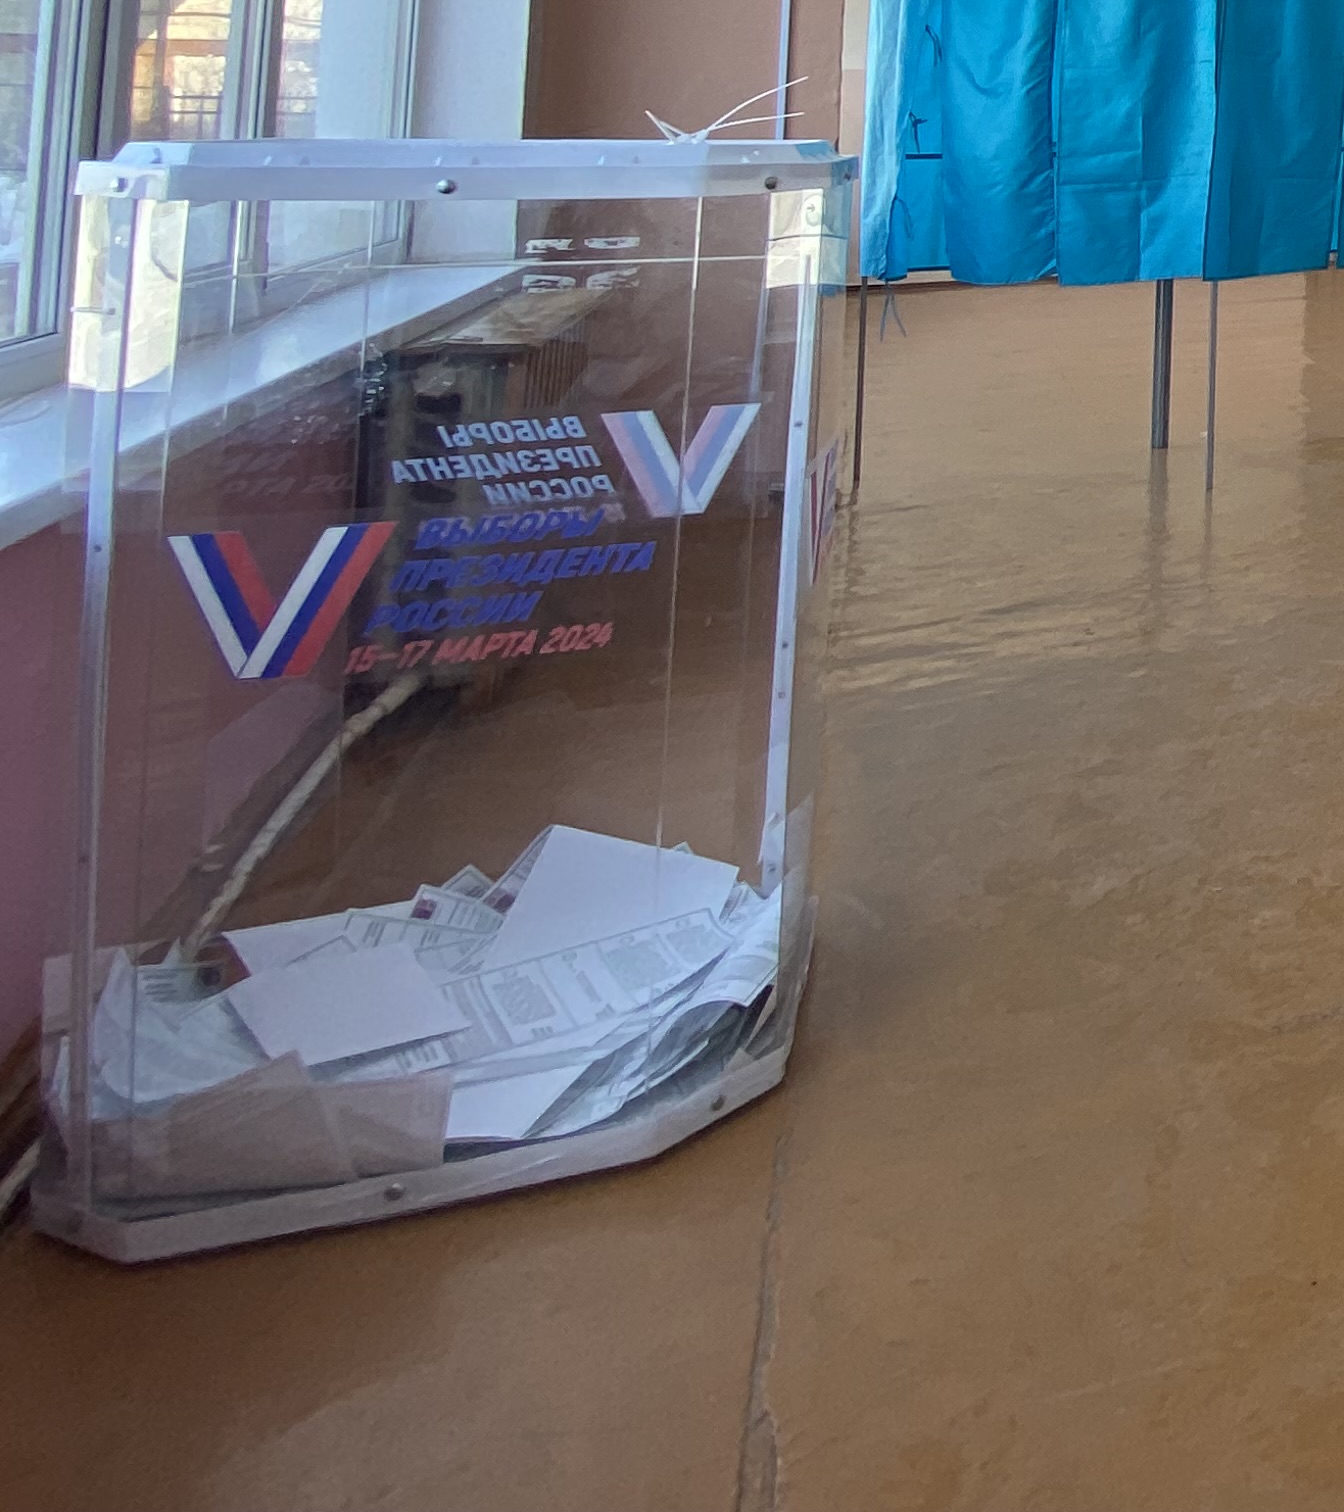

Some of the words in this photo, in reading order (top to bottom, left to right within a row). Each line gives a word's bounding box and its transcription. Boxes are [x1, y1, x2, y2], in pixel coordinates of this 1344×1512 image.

[413, 508, 606, 551] ВЫБОРЫ
[390, 541, 657, 593] ПРЕЗИДЕНТА
[362, 590, 544, 636] РОССИИ
[431, 629, 539, 666] МАРТА
[539, 621, 616, 655] 2024
